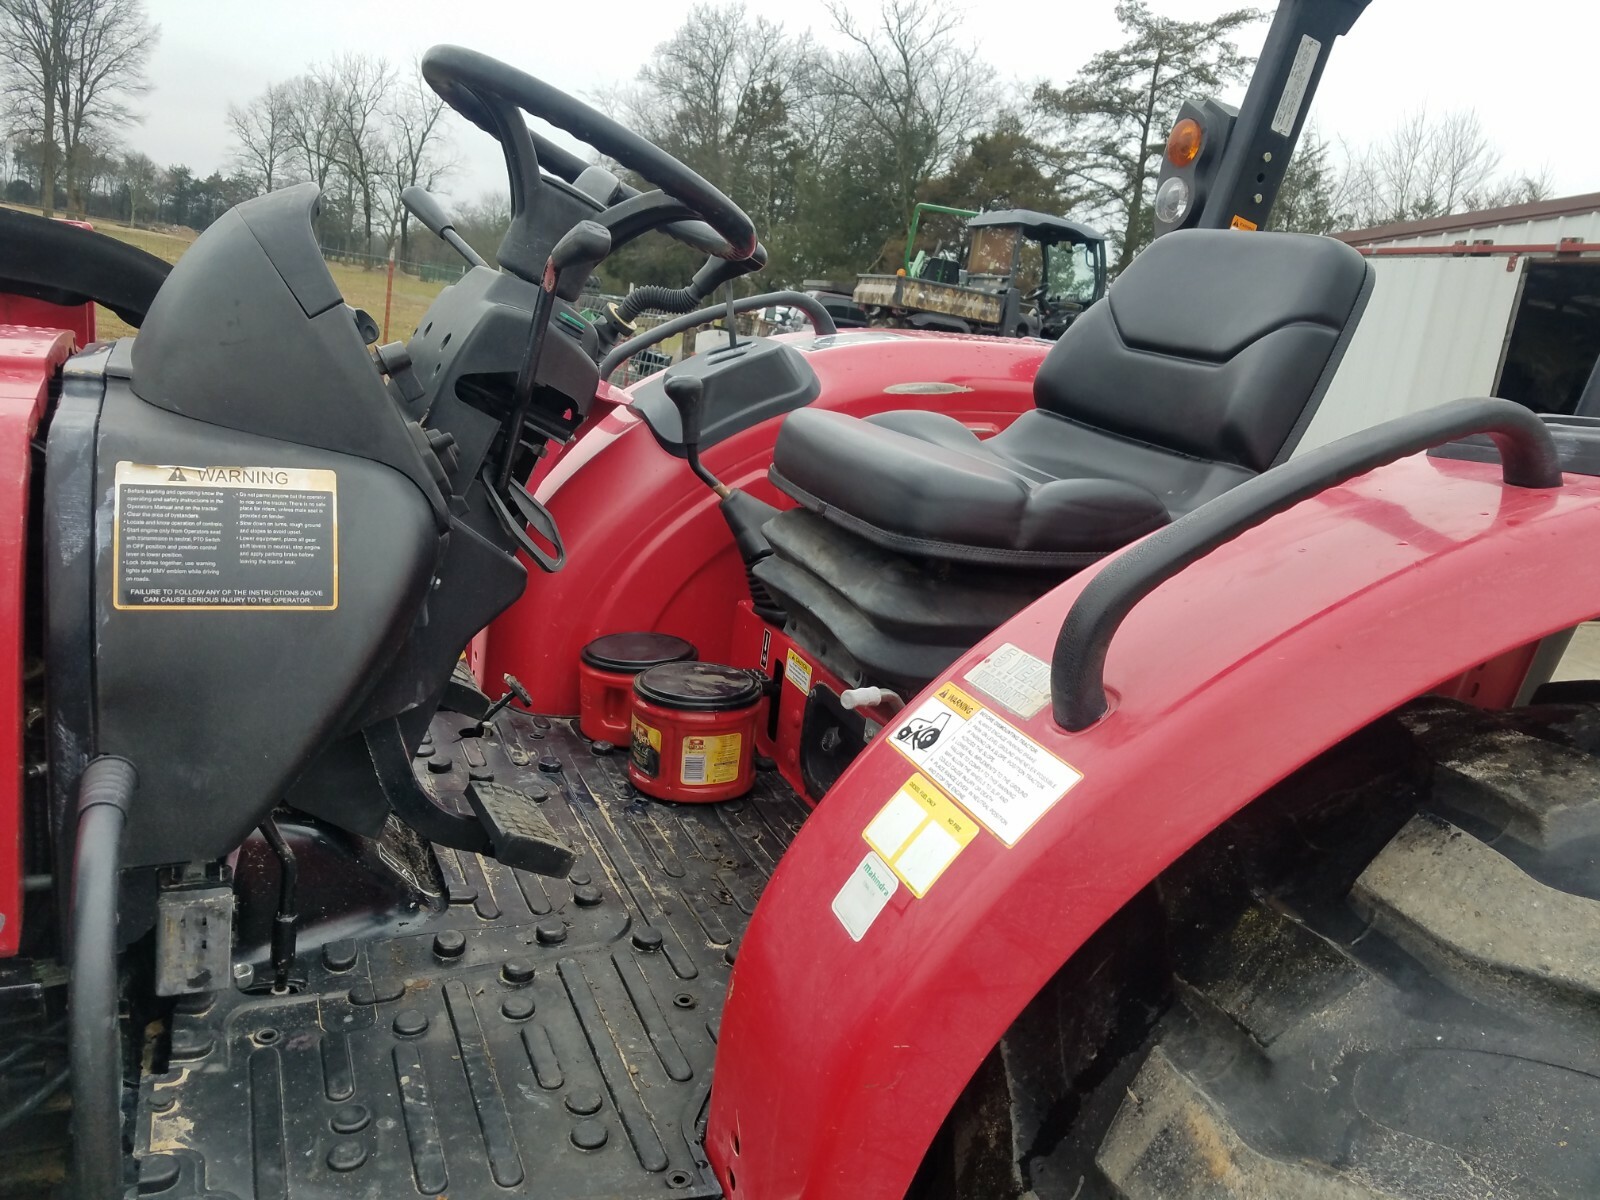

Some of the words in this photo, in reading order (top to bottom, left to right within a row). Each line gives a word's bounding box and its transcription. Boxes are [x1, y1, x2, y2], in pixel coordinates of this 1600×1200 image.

[198, 469, 288, 485] WARNING
[993, 648, 1019, 668] 5
[972, 670, 1033, 710] WARRANTY
[948, 694, 974, 714] WARNING
[1018, 739, 1039, 754] TRACTOR
[909, 782, 920, 793] DIESEL
[920, 792, 928, 801] FUEL
[926, 798, 936, 808] ONLY
[953, 823, 962, 832] FIRE
[863, 863, 890, 897] Mahindra
